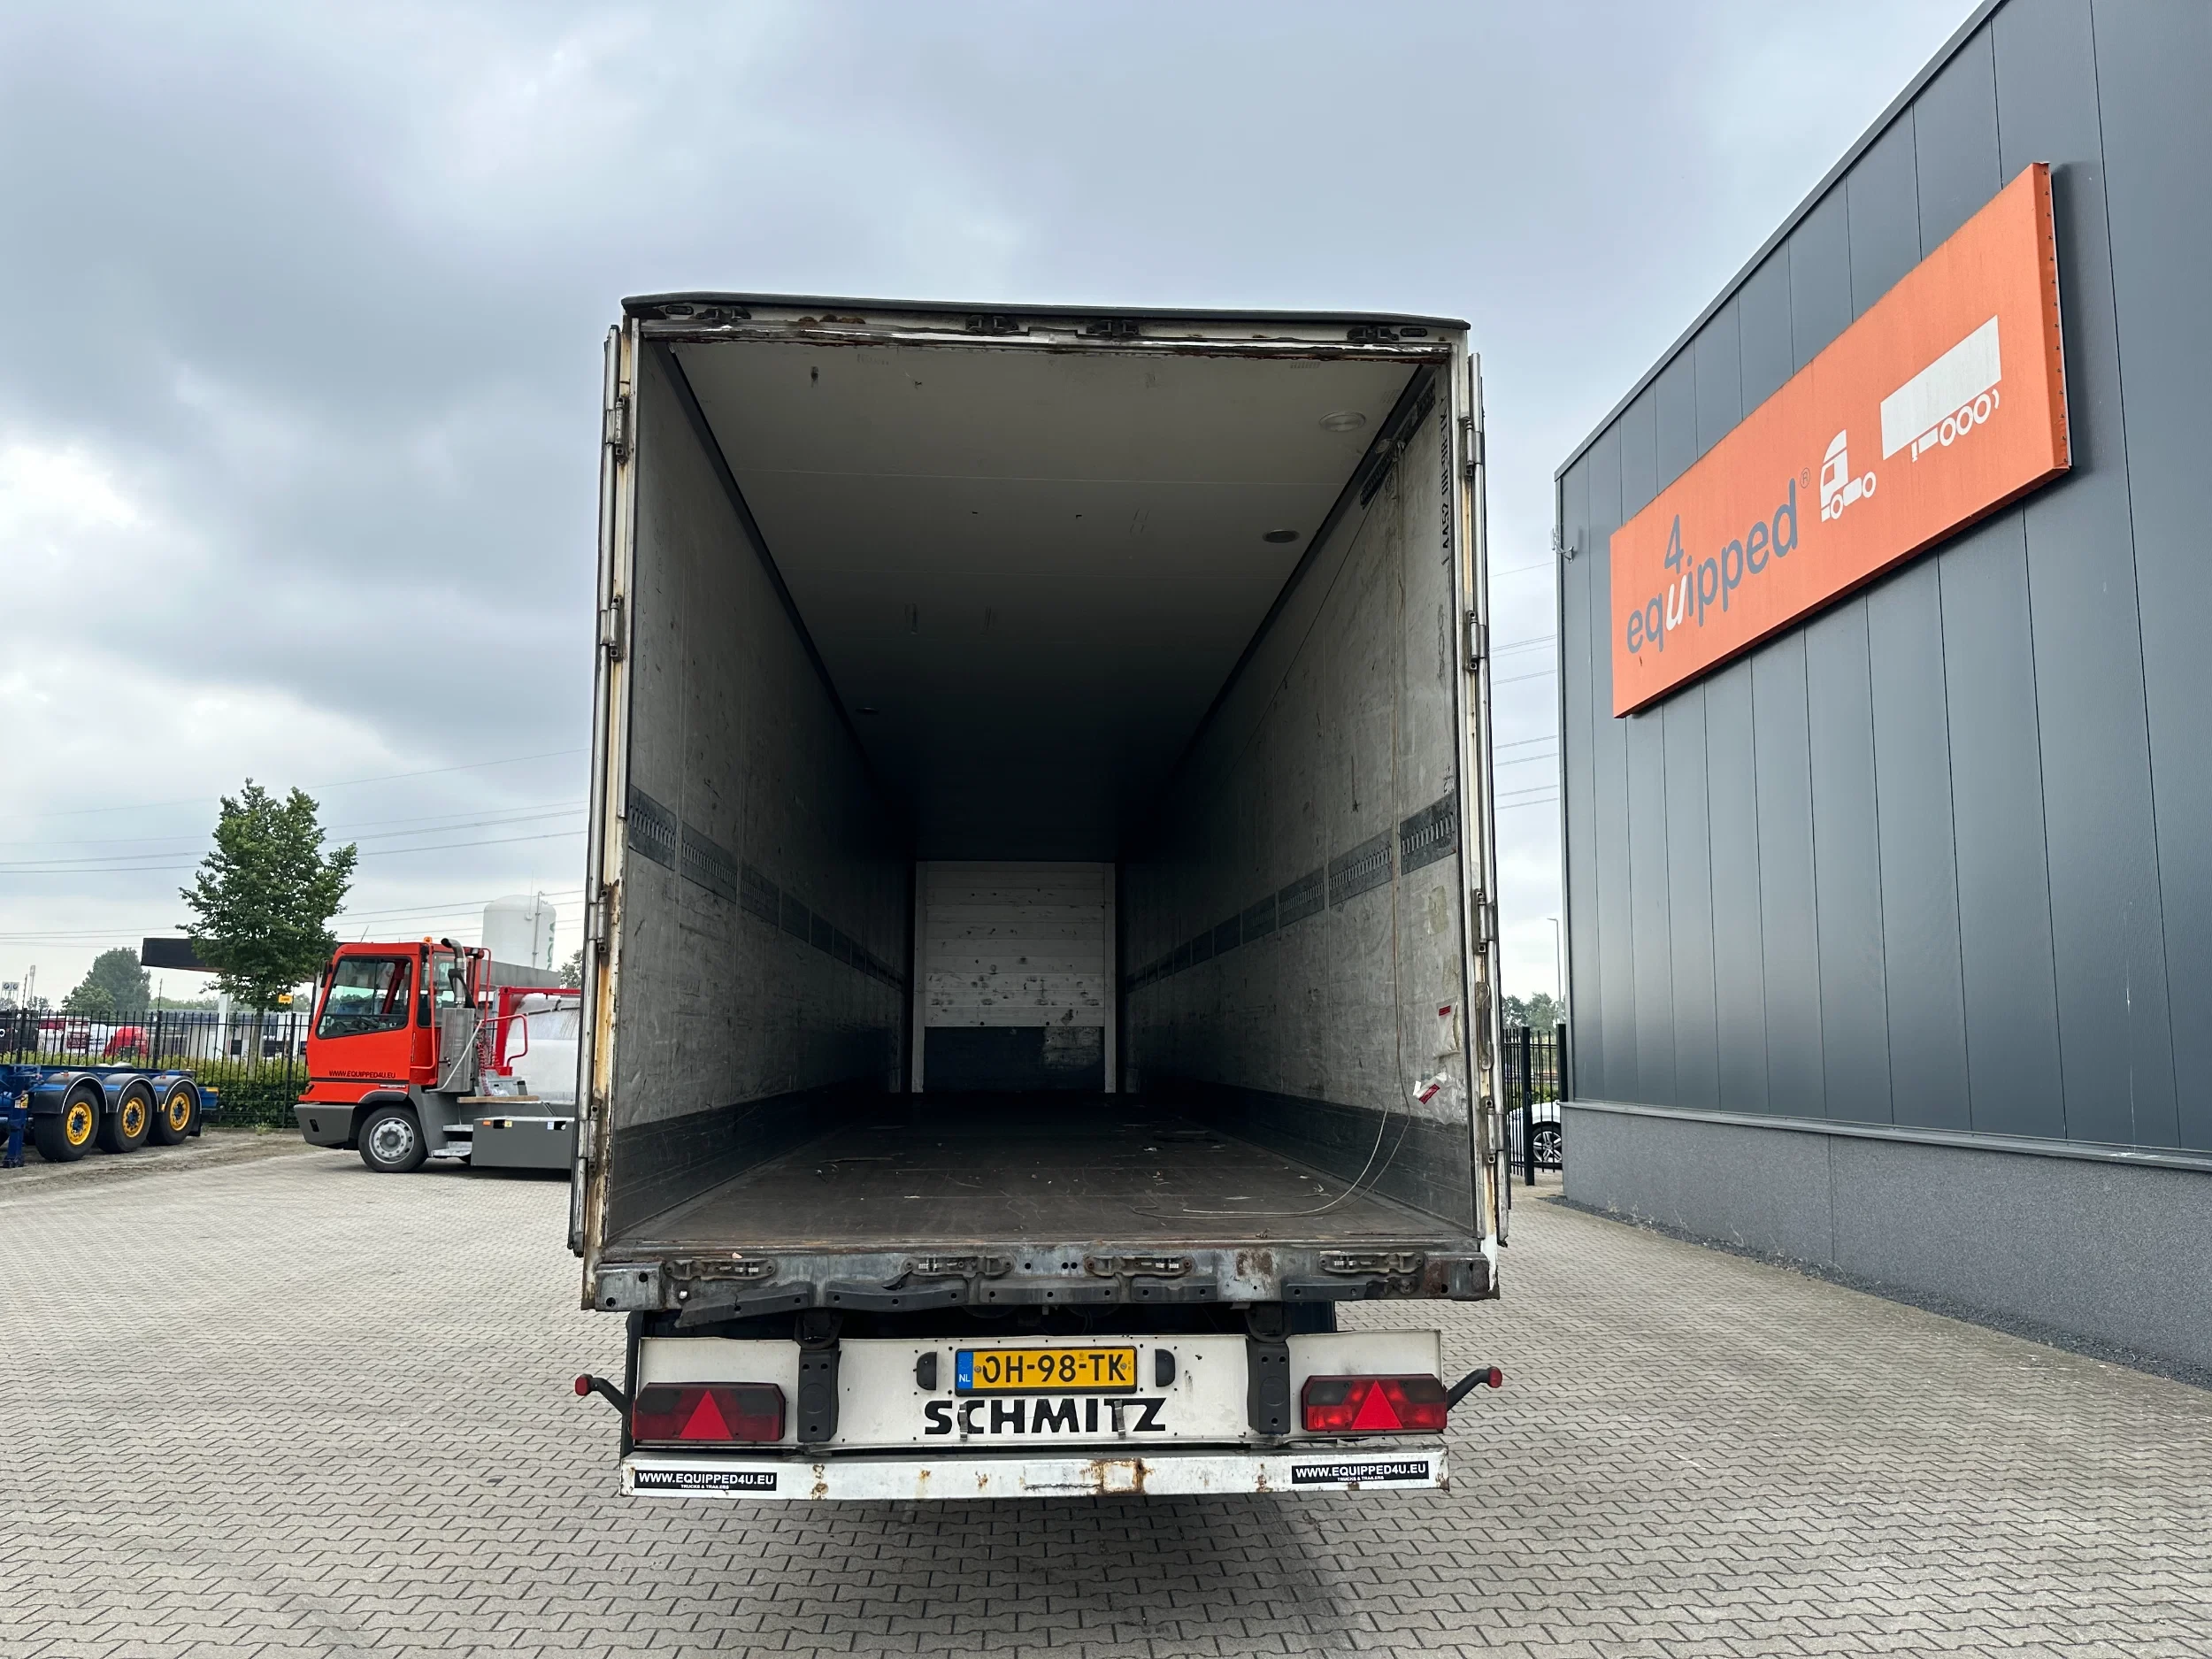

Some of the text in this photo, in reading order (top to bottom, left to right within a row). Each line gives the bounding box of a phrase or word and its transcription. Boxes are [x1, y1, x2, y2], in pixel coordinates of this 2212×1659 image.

[1663, 513, 1685, 574] 4
[328, 1070, 396, 1079] WWW.EQUIPPED4U.EU
[982, 1353, 1126, 1384] OH-98-TK
[958, 1373, 972, 1383] NL
[924, 1397, 1167, 1435] SCHMITZ
[638, 1472, 774, 1485] WWW.EQUIPPED4U.EU
[1295, 1463, 1426, 1479] WWW.EQUIPPED4U.EU
